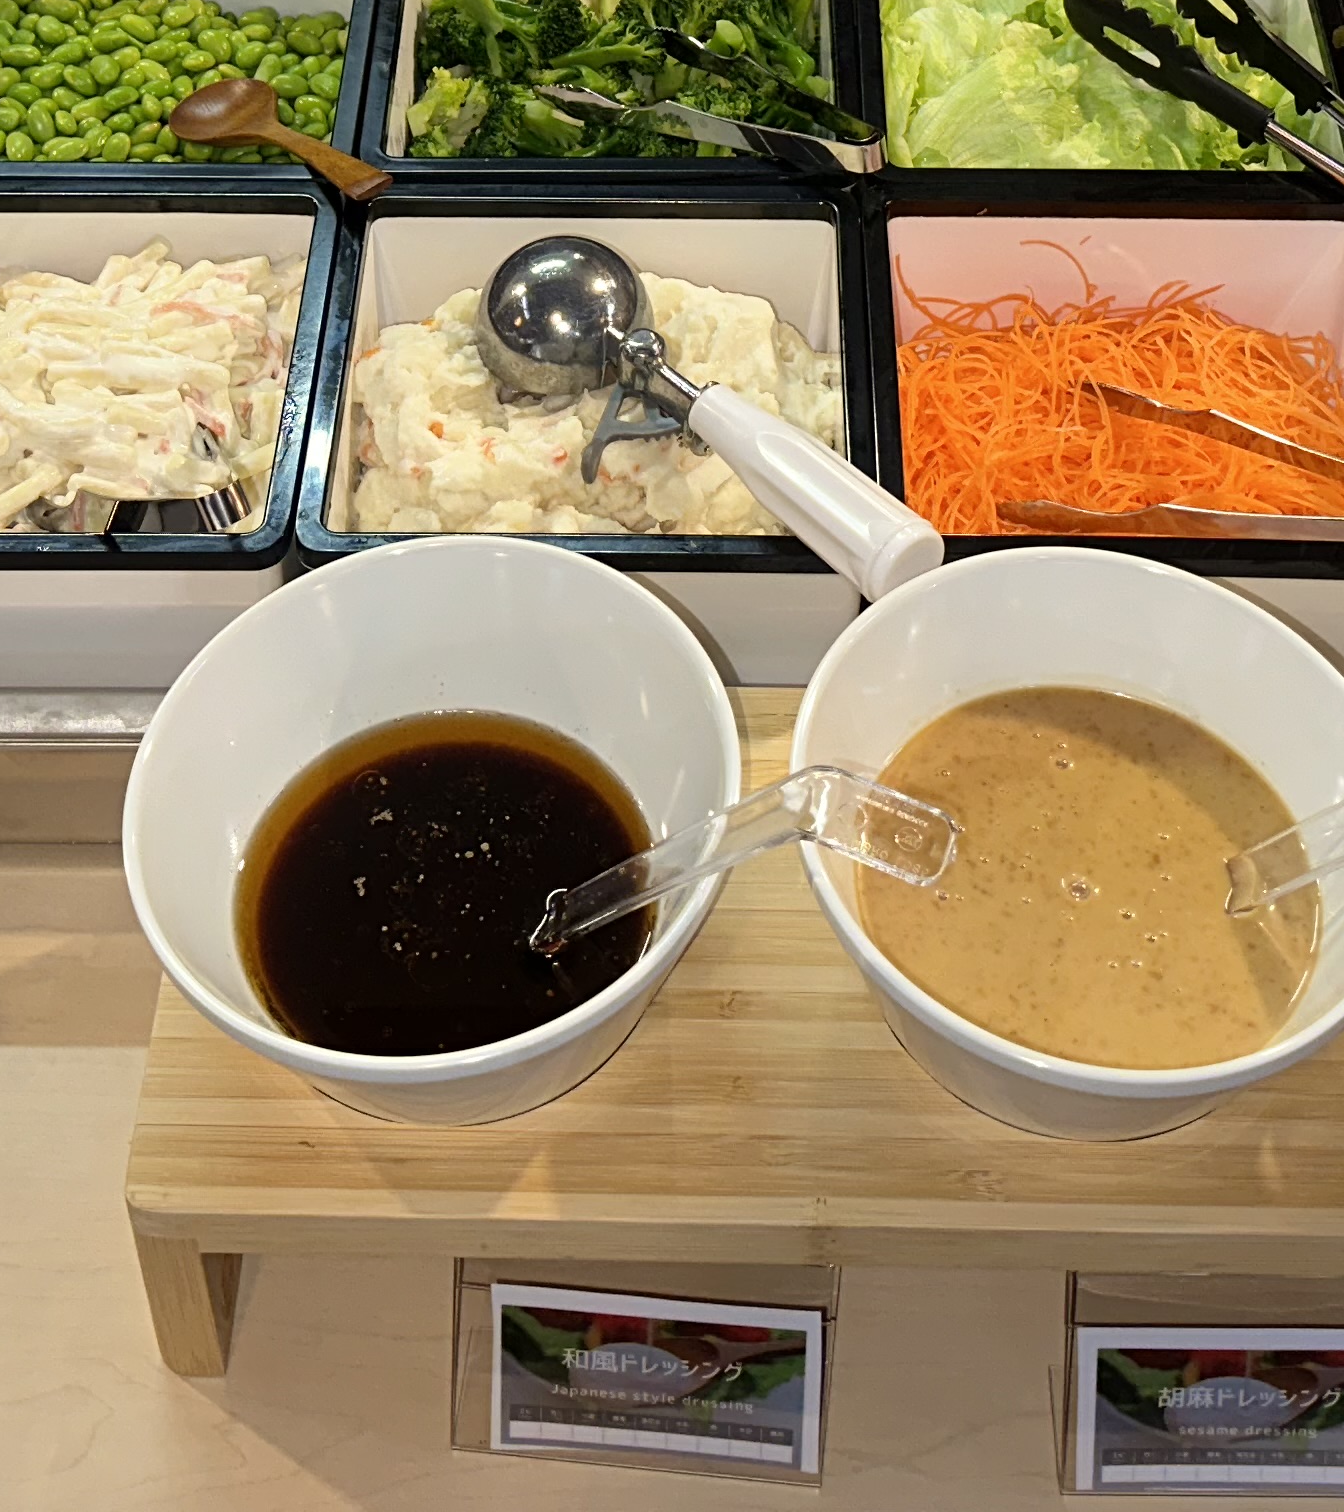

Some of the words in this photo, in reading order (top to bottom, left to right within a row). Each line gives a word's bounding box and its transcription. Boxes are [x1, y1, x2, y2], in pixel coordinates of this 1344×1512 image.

[561, 1346, 744, 1383] 和風ドレッシング
[551, 1384, 627, 1400] Japanese
[632, 1391, 676, 1405] style
[1157, 1386, 1343, 1410] 胡麻ドレッシング
[1178, 1426, 1239, 1436] sesame
[1245, 1425, 1318, 1439] dressing
